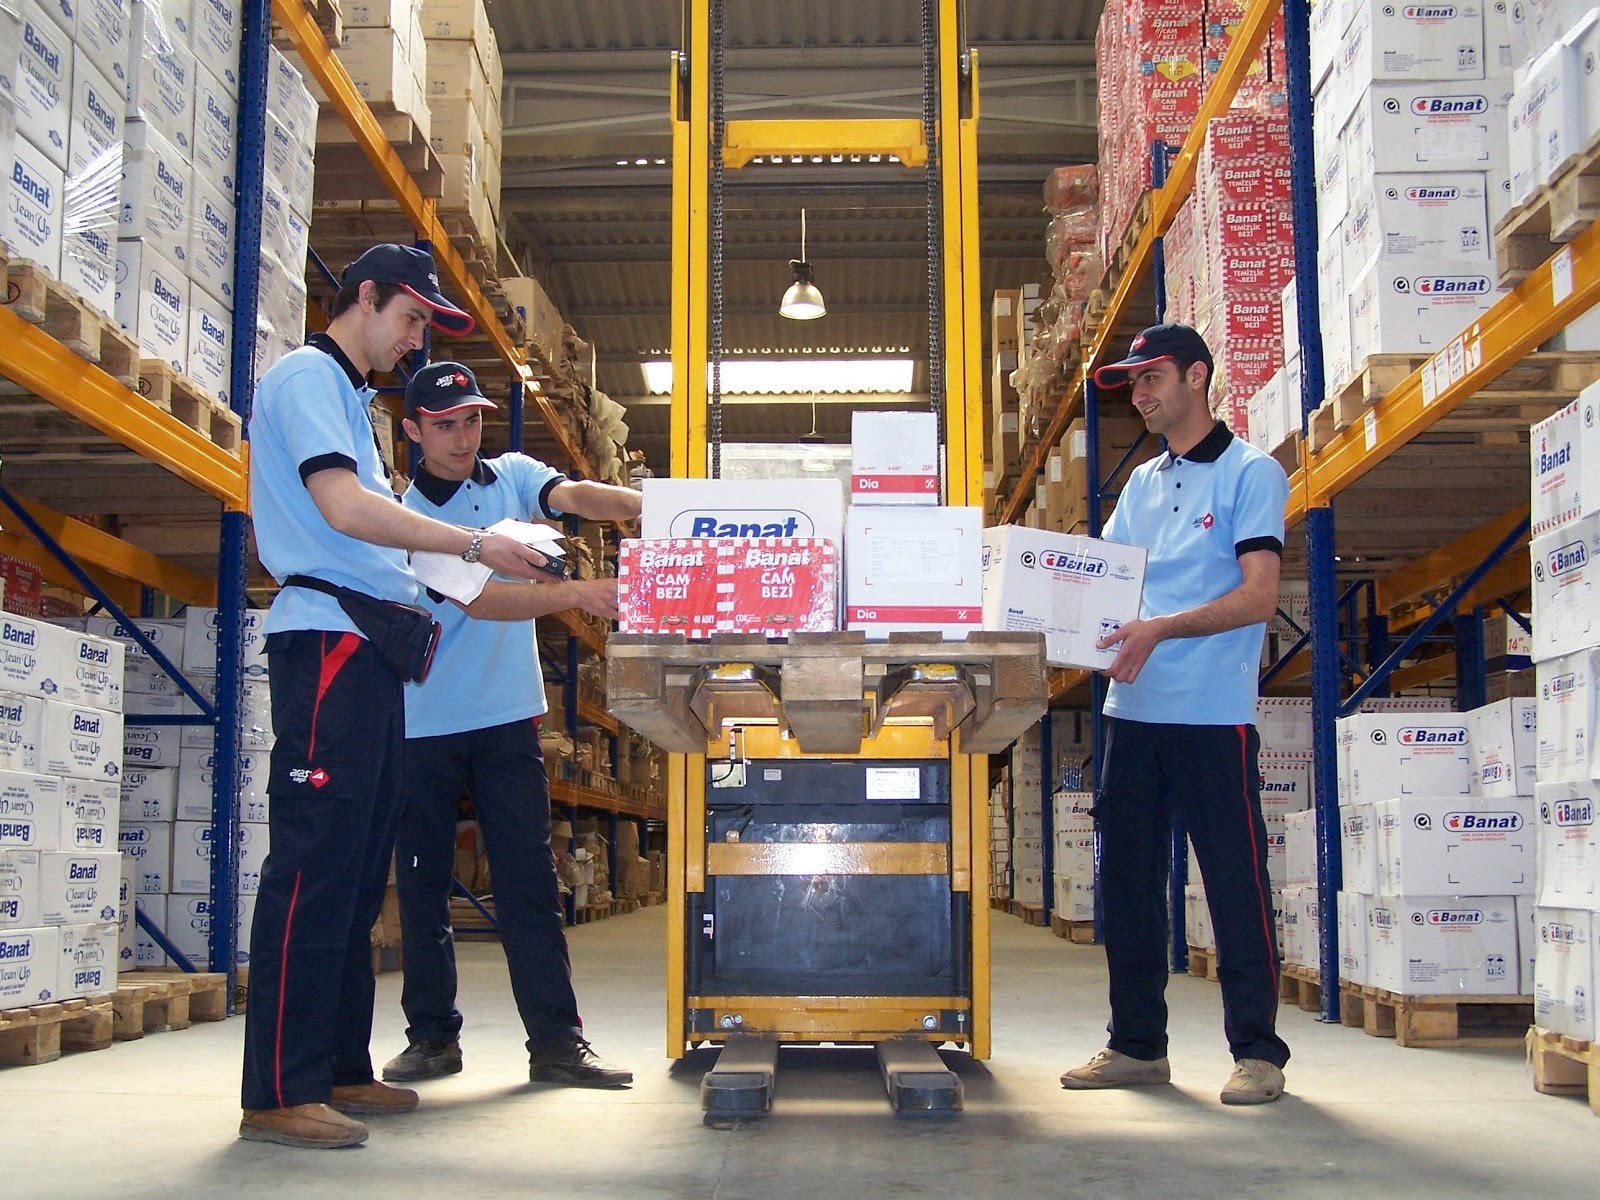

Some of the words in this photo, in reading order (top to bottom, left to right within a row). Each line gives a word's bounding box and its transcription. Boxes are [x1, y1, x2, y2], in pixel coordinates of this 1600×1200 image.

[209, 0, 233, 26] anat
[1416, 7, 1454, 18] Banat
[1154, 19, 1189, 28] Banat
[24, 22, 59, 75] Banat
[1152, 89, 1188, 98] Banat
[88, 89, 116, 135] Banat
[1430, 99, 1483, 112] Banat
[207, 96, 230, 132] Banat
[1217, 125, 1253, 136] Banat
[1267, 124, 1290, 133] Ban
[157, 161, 183, 199] Banat
[1225, 169, 1261, 180] Banat
[13, 160, 50, 208] Banat
[1418, 189, 1456, 199] Banat
[205, 204, 227, 238] Banat
[1226, 213, 1263, 224] Banat
[1229, 258, 1266, 269] Banat
[1433, 279, 1486, 292] Banat
[154, 277, 181, 312] Banat
[1233, 304, 1270, 314] Banat
[202, 314, 225, 345] Banat
[1234, 351, 1270, 361] Banat
[1541, 442, 1571, 475] Banat
[859, 478, 879, 489] Dia
[691, 517, 799, 538] Banat
[640, 550, 705, 567] Banat
[744, 549, 811, 567] Banat
[1056, 555, 1104, 574] Banat
[1557, 546, 1585, 570] Banat
[655, 573, 690, 586] CAM
[761, 572, 795, 585] CAM
[656, 585, 687, 599] BEZİ
[762, 584, 793, 598] BEZİ
[857, 609, 876, 619] Dia
[3, 623, 36, 646] Banat
[113, 625, 157, 640] Baat
[80, 643, 109, 663] Banat
[0, 704, 23, 723] anat
[74, 714, 100, 733] Banat
[1415, 730, 1465, 742] Banat
[124, 747, 153, 760] Ban
[1259, 782, 1297, 792] Banat
[1564, 803, 1592, 820] Banat
[1463, 815, 1517, 828] Banat
[76, 827, 102, 843] Banat
[121, 830, 145, 841] nat
[69, 863, 97, 879] Banat
[1441, 911, 1480, 922] Banat
[0, 940, 30, 959] Banat
[1, 968, 17, 981] lean
[75, 971, 101, 986] Banat
